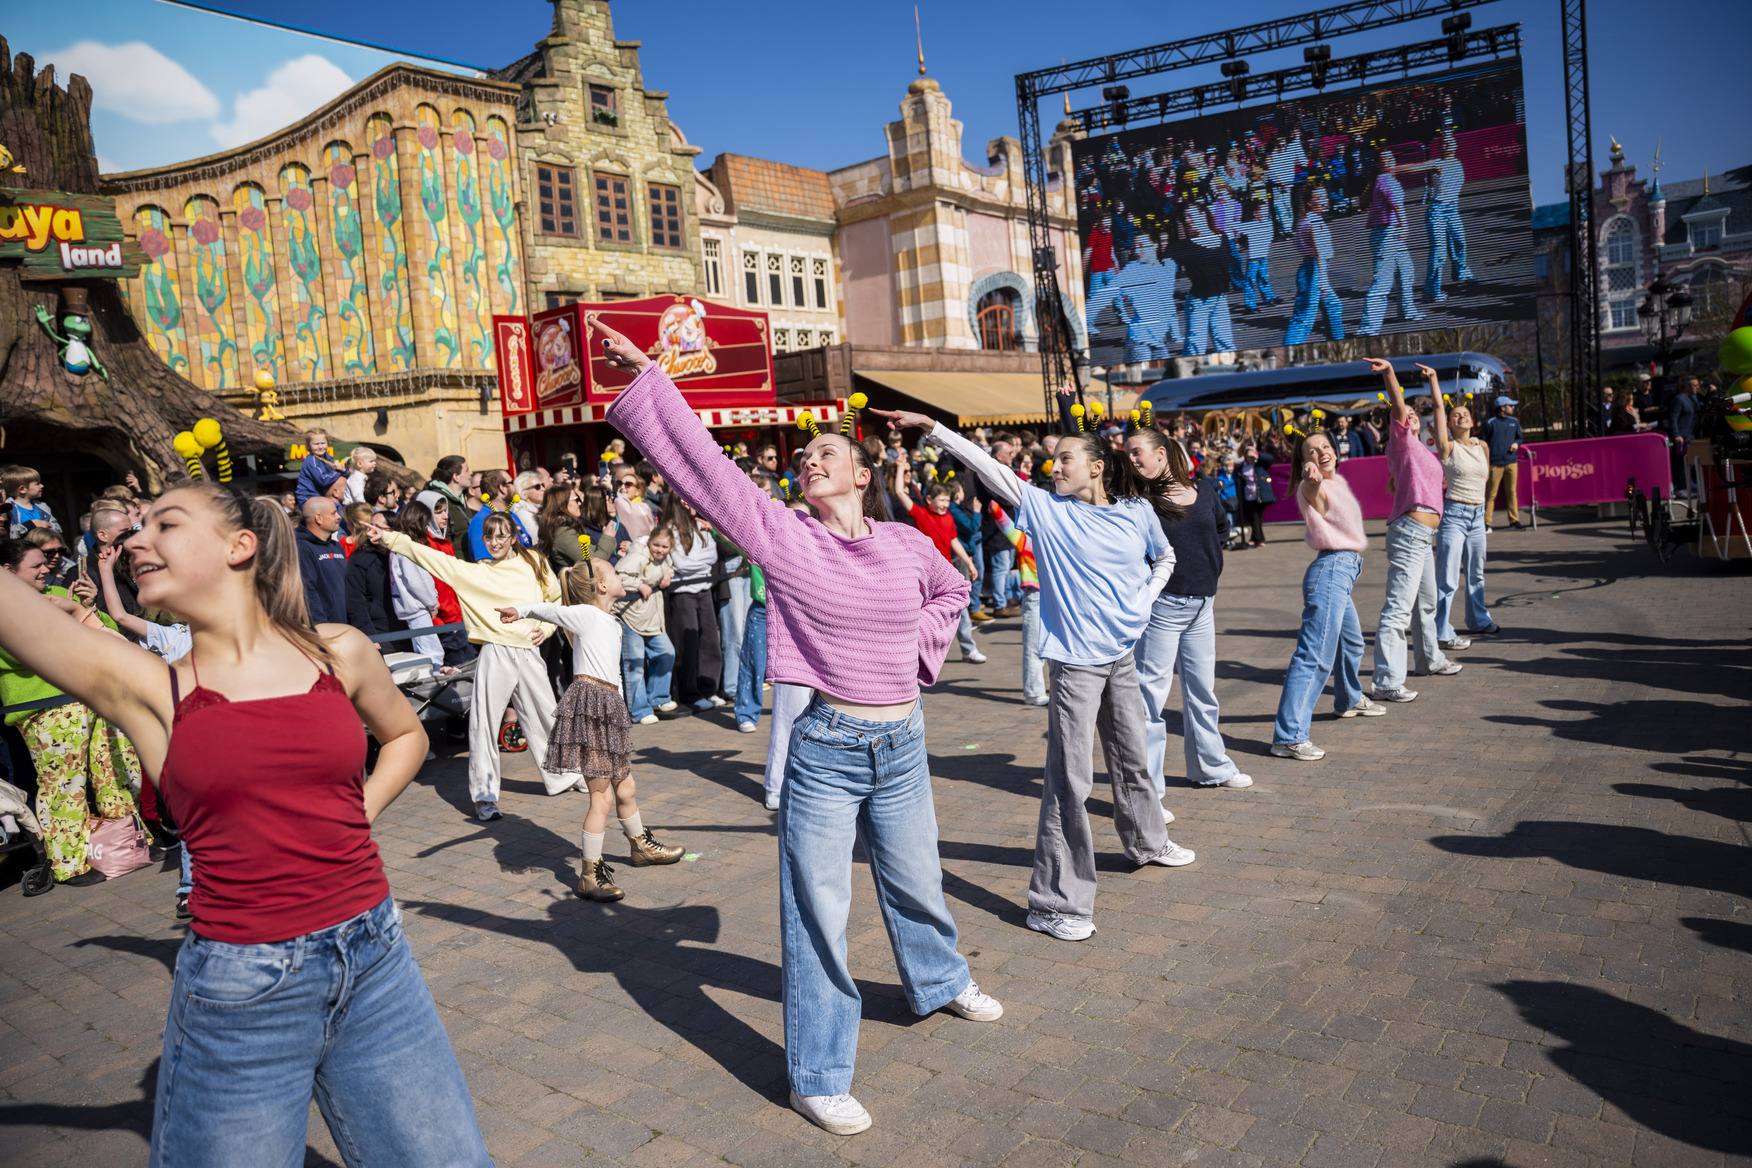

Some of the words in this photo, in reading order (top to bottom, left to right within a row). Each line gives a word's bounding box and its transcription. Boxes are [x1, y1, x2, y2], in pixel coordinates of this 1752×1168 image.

[0, 206, 84, 250] aya
[60, 243, 122, 269] land
[1533, 463, 1594, 482] Plopsa
